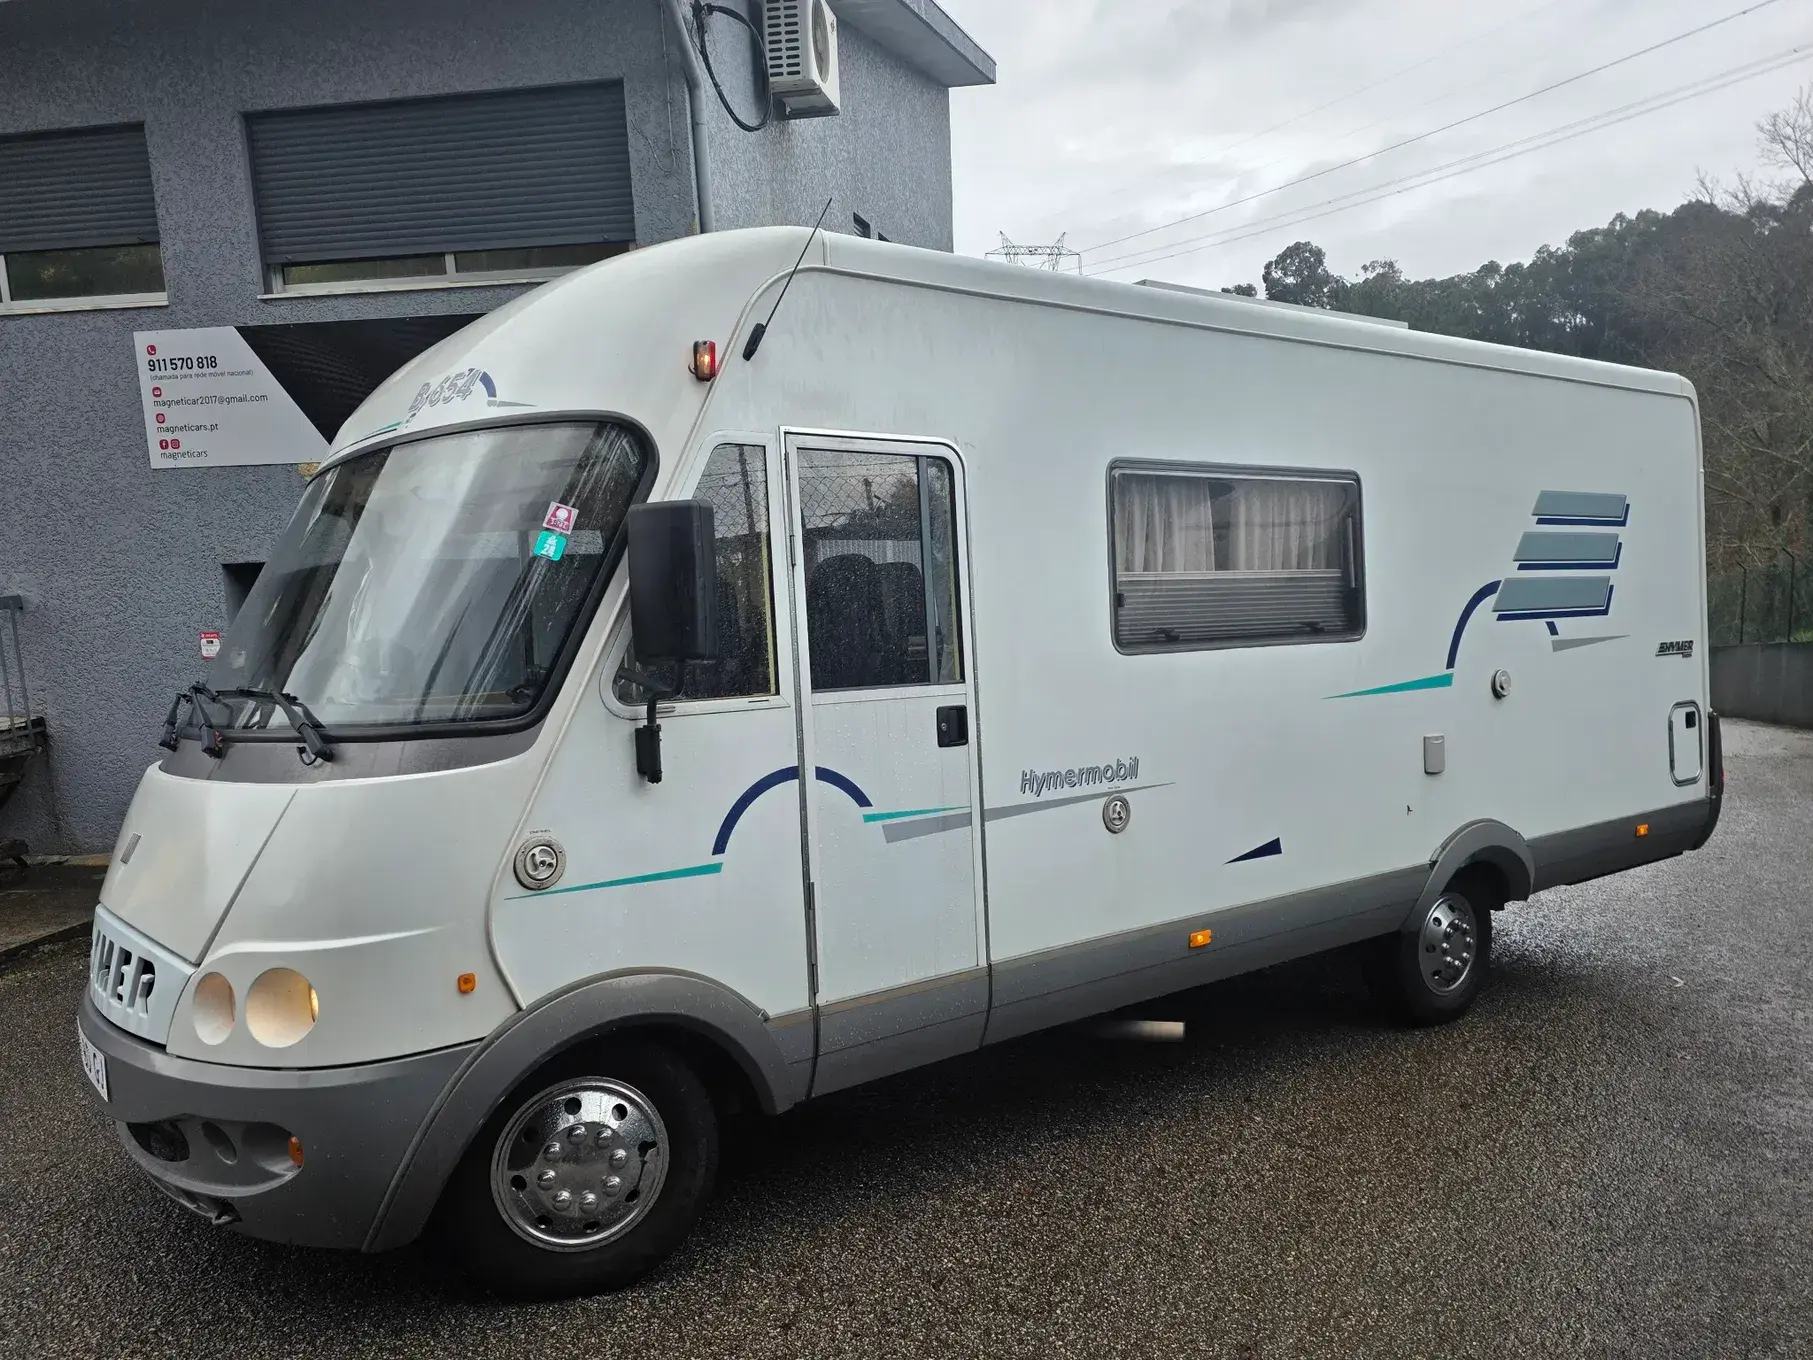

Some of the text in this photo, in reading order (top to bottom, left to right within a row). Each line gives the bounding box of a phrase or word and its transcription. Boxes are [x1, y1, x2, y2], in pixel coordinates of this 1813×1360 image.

[148, 356, 217, 371] 911 570 818
[150, 374, 179, 382] (chamada
[154, 394, 268, 408] magneticar2017@gmail.com
[157, 423, 219, 434] magneticars.pt
[160, 450, 208, 460] magneticars
[1020, 756, 1139, 797] Hymermobil
